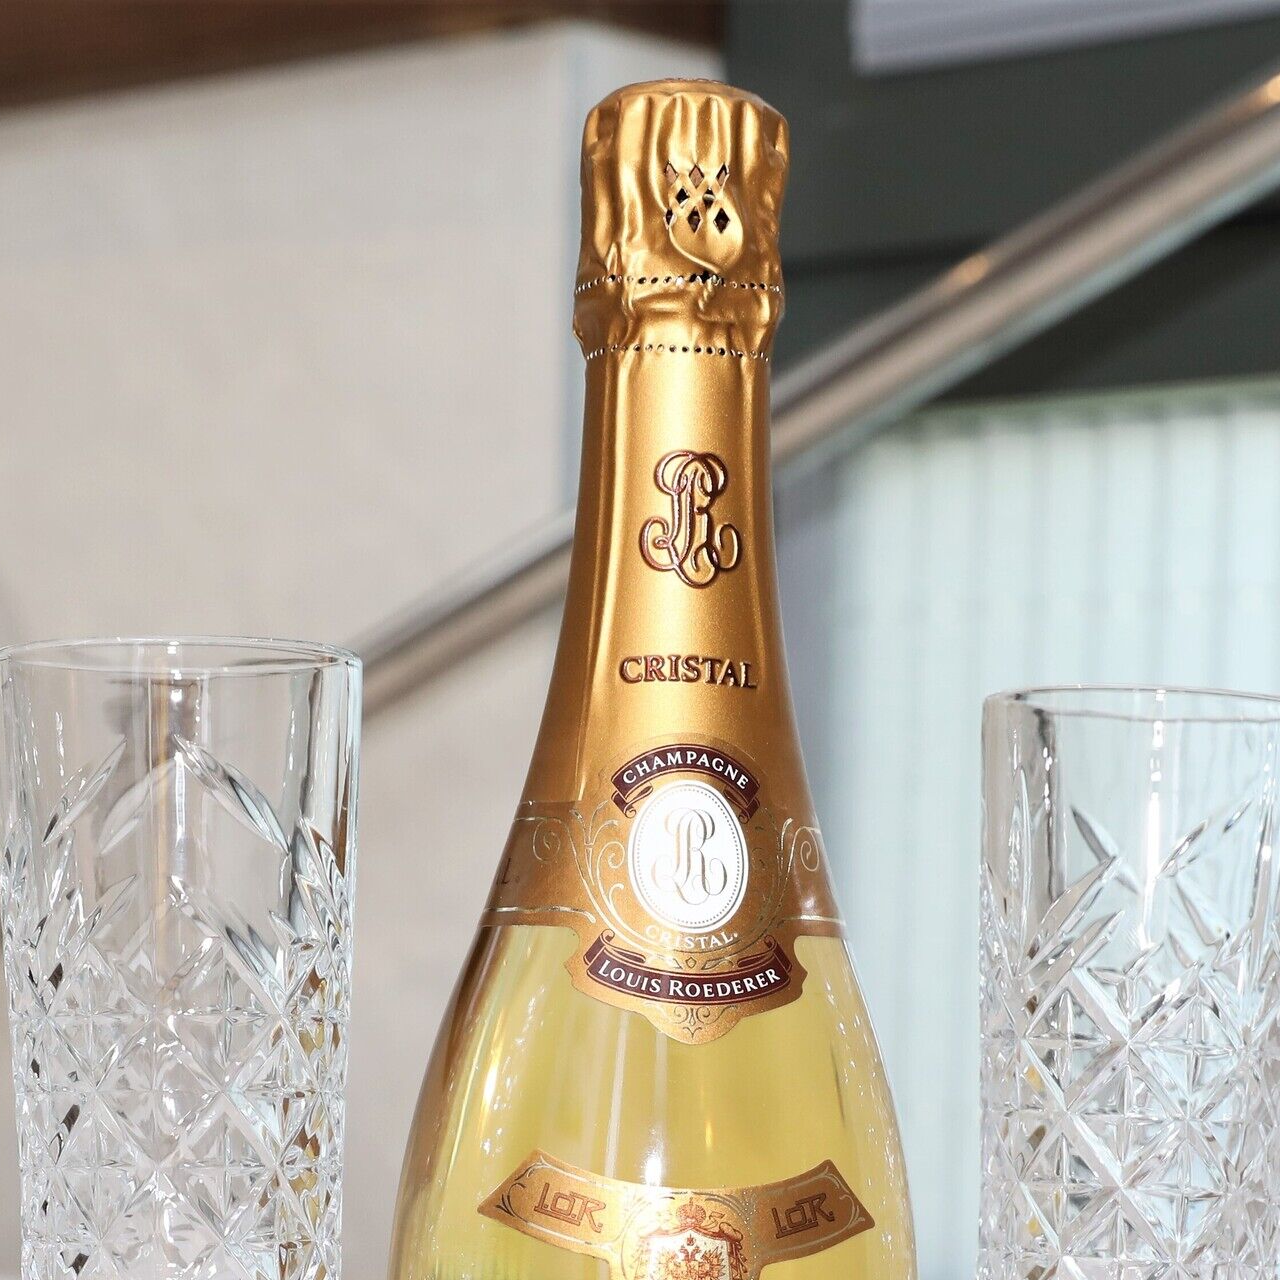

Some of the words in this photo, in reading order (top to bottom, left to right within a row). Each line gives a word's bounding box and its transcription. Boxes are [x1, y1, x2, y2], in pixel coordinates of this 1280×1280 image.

[619, 654, 759, 690] CRISTAL
[622, 750, 749, 790] CHAMPAGNE
[597, 959, 662, 993] LOUIS
[668, 968, 781, 998] ROEDERER
